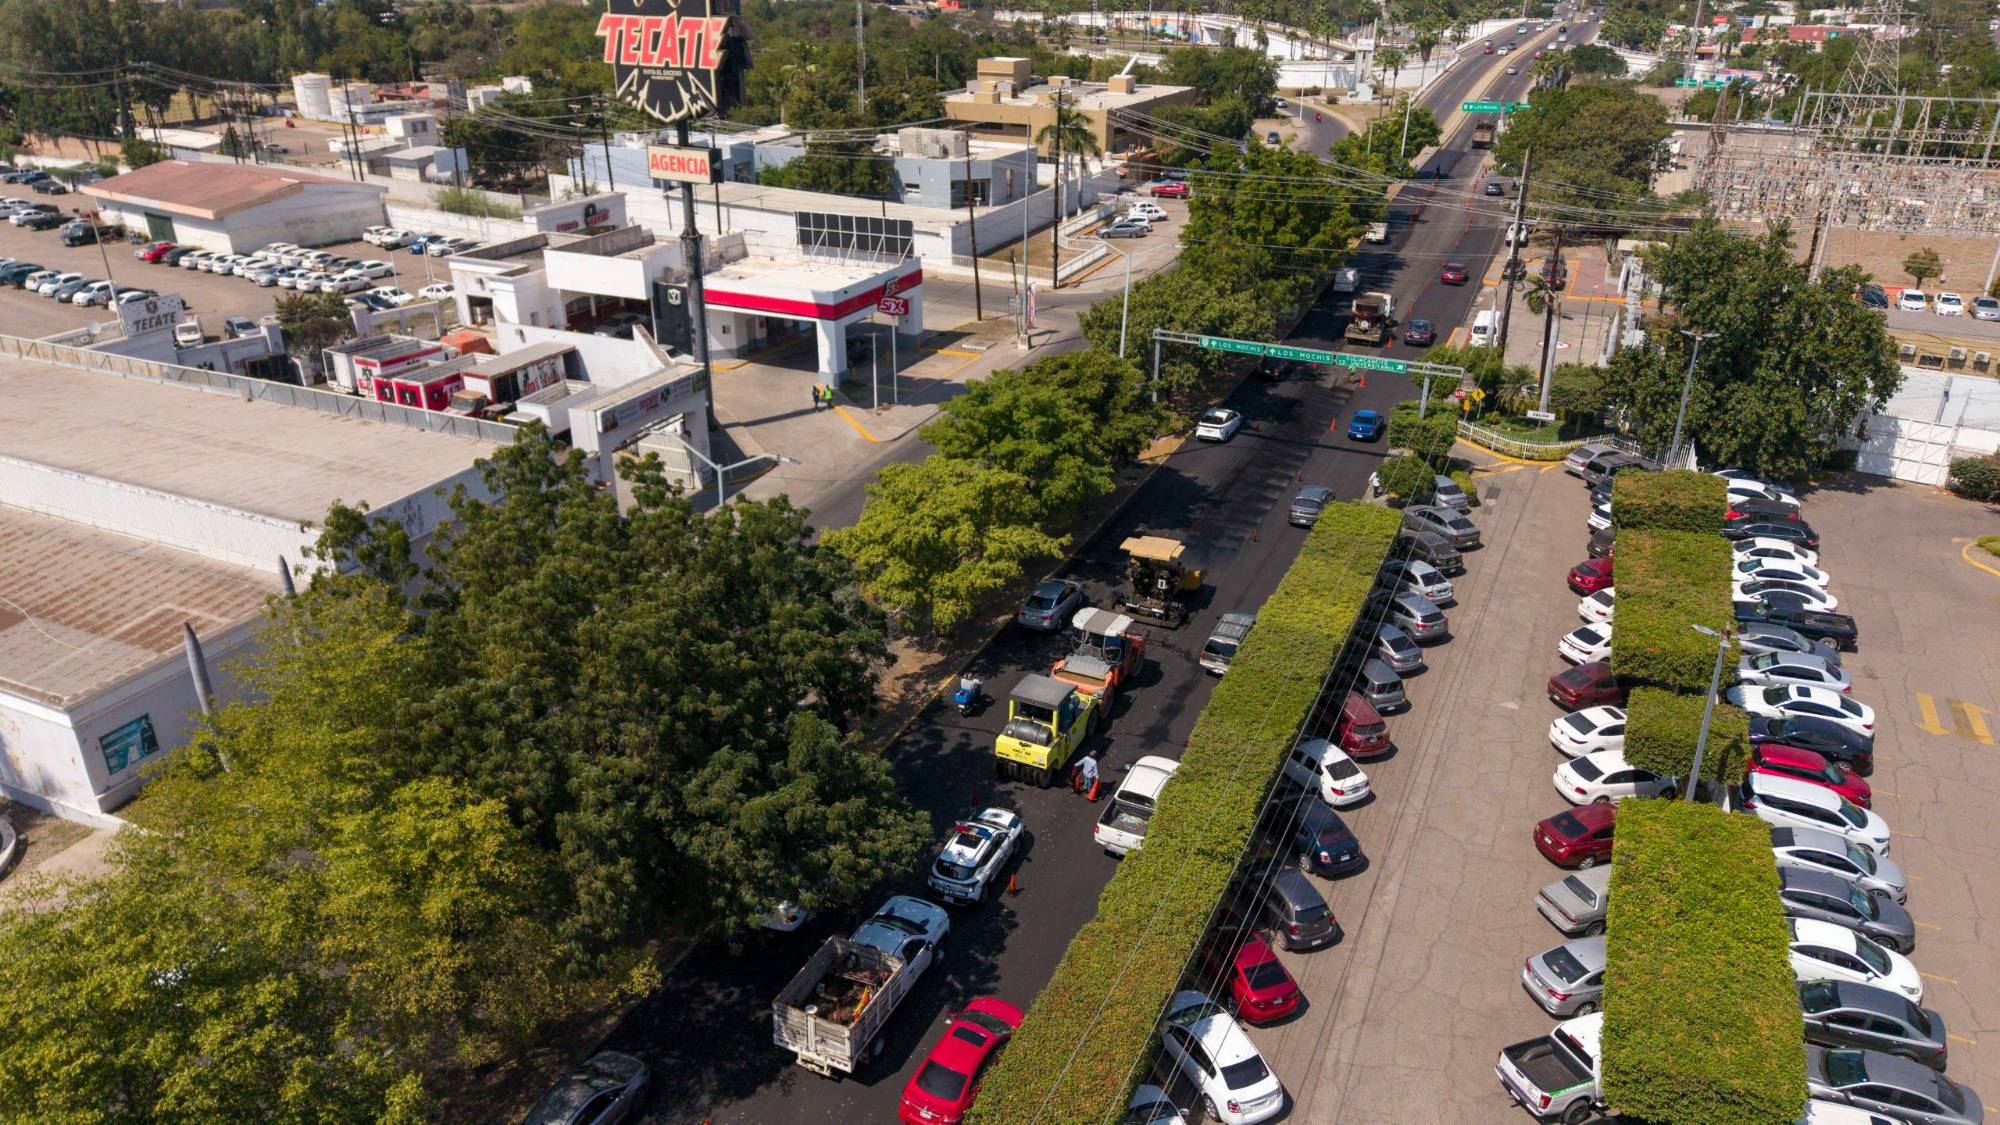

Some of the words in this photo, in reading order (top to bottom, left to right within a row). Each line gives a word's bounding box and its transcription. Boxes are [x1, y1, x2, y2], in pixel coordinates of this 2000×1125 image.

[595, 12, 729, 69] TECATE
[650, 153, 708, 176] AGENCIA
[133, 312, 177, 332] TECATE
[1236, 344, 1261, 352] MOCHIS
[1299, 352, 1331, 361] MOCHIS
